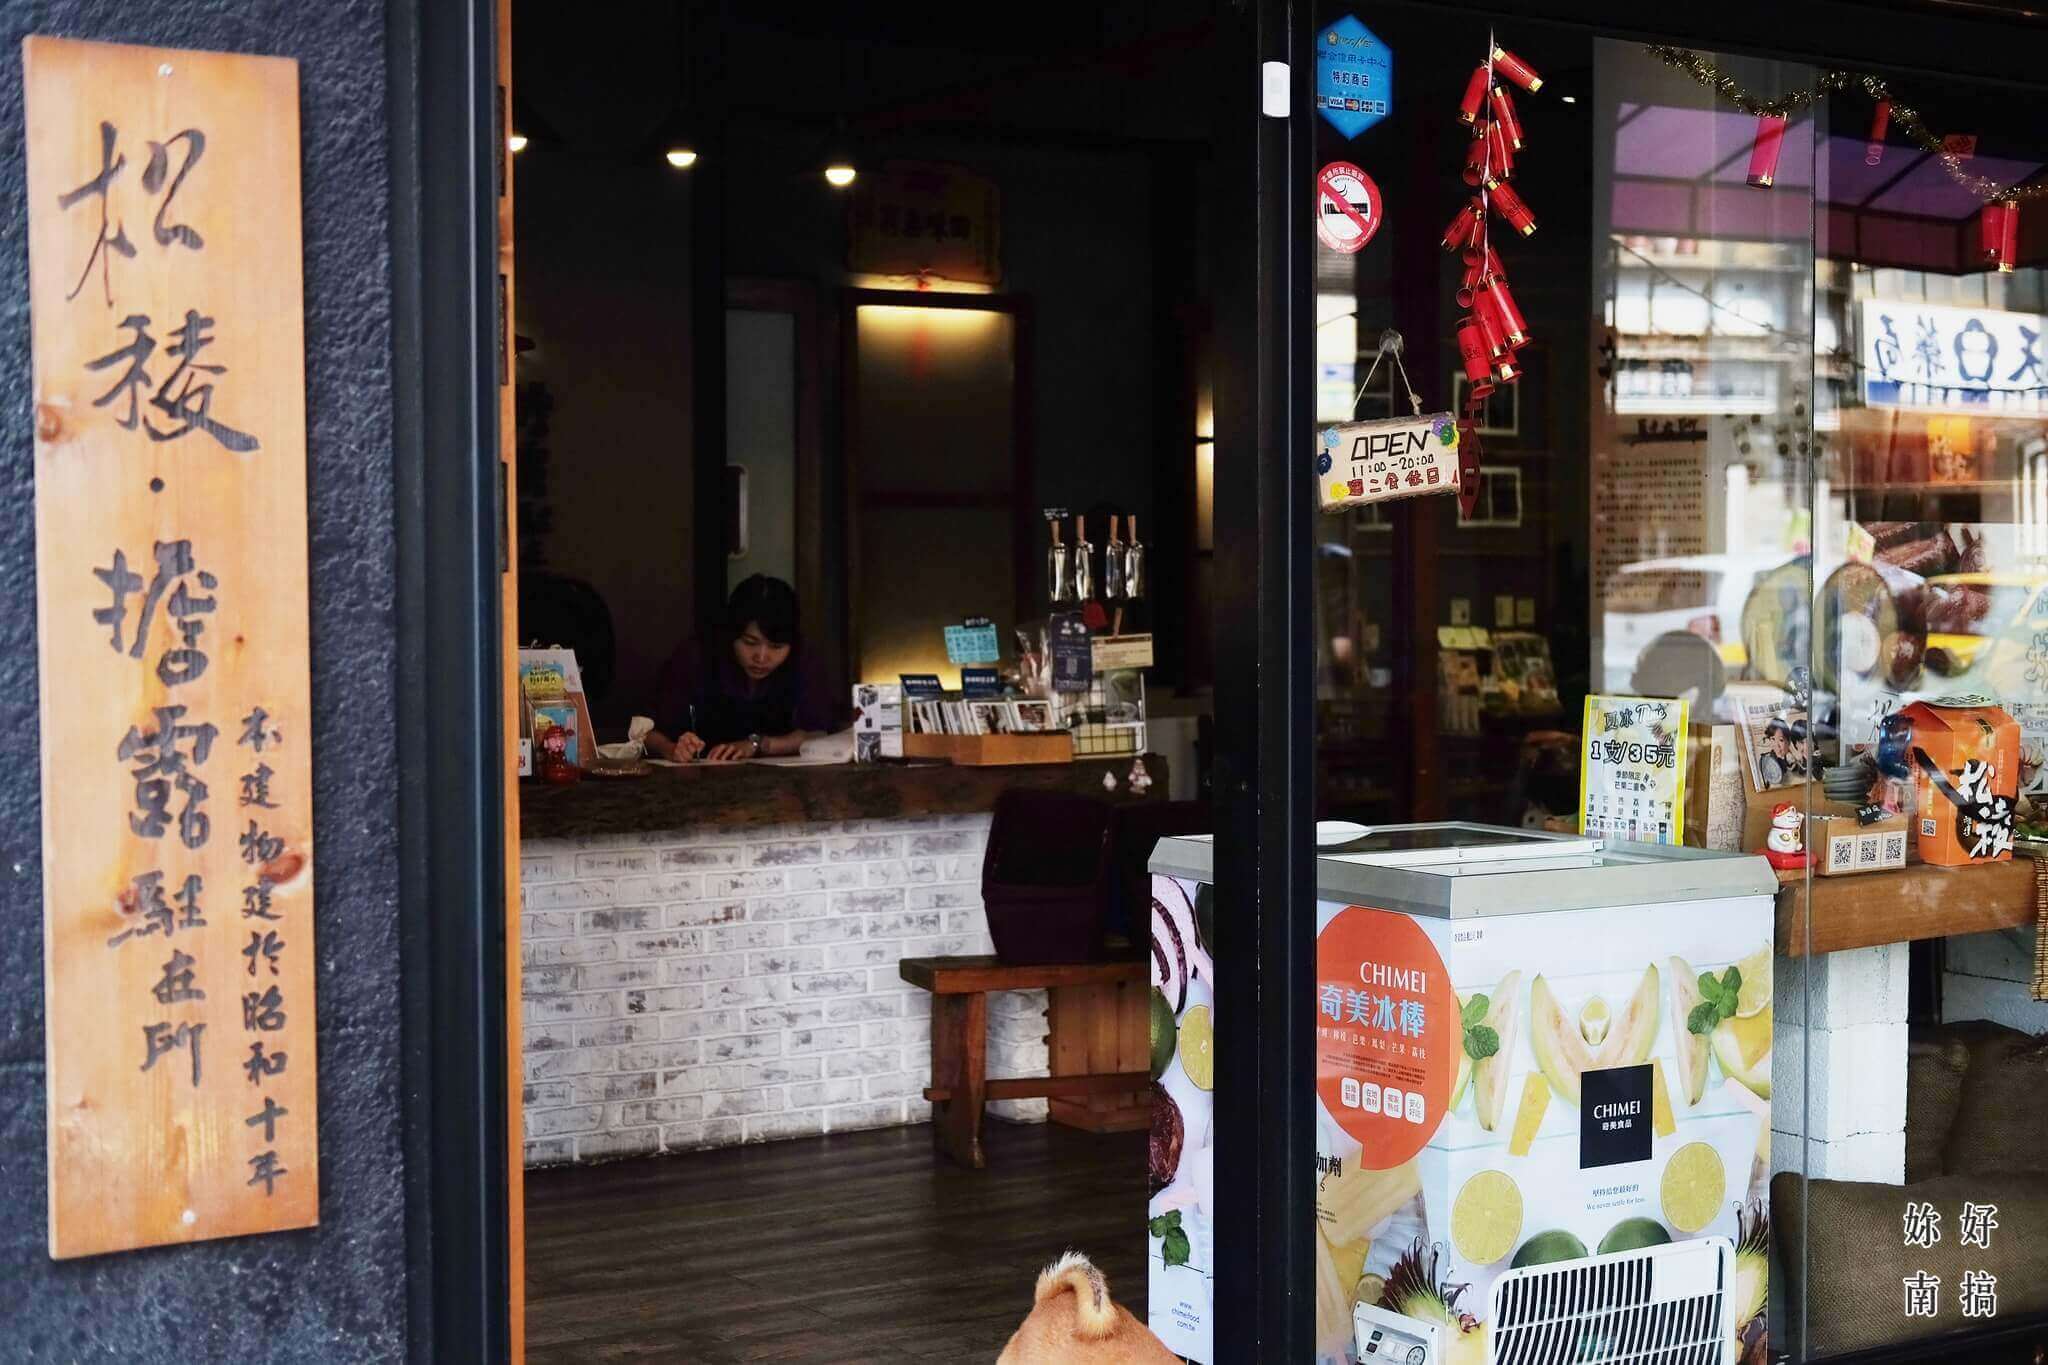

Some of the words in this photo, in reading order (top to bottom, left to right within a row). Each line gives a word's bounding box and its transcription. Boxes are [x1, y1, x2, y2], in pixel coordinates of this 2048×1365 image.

[1332, 70, 1369, 87] 特約商店
[1351, 430, 1431, 461] OPEN
[237, 706, 289, 1197] 本建物建於昭和十年
[1359, 961, 1426, 994] CHIMEI
[1319, 984, 1425, 1039] 奇美冰棒
[1593, 1100, 1641, 1119] CHIMEI
[1602, 1119, 1632, 1131] 奇美食品
